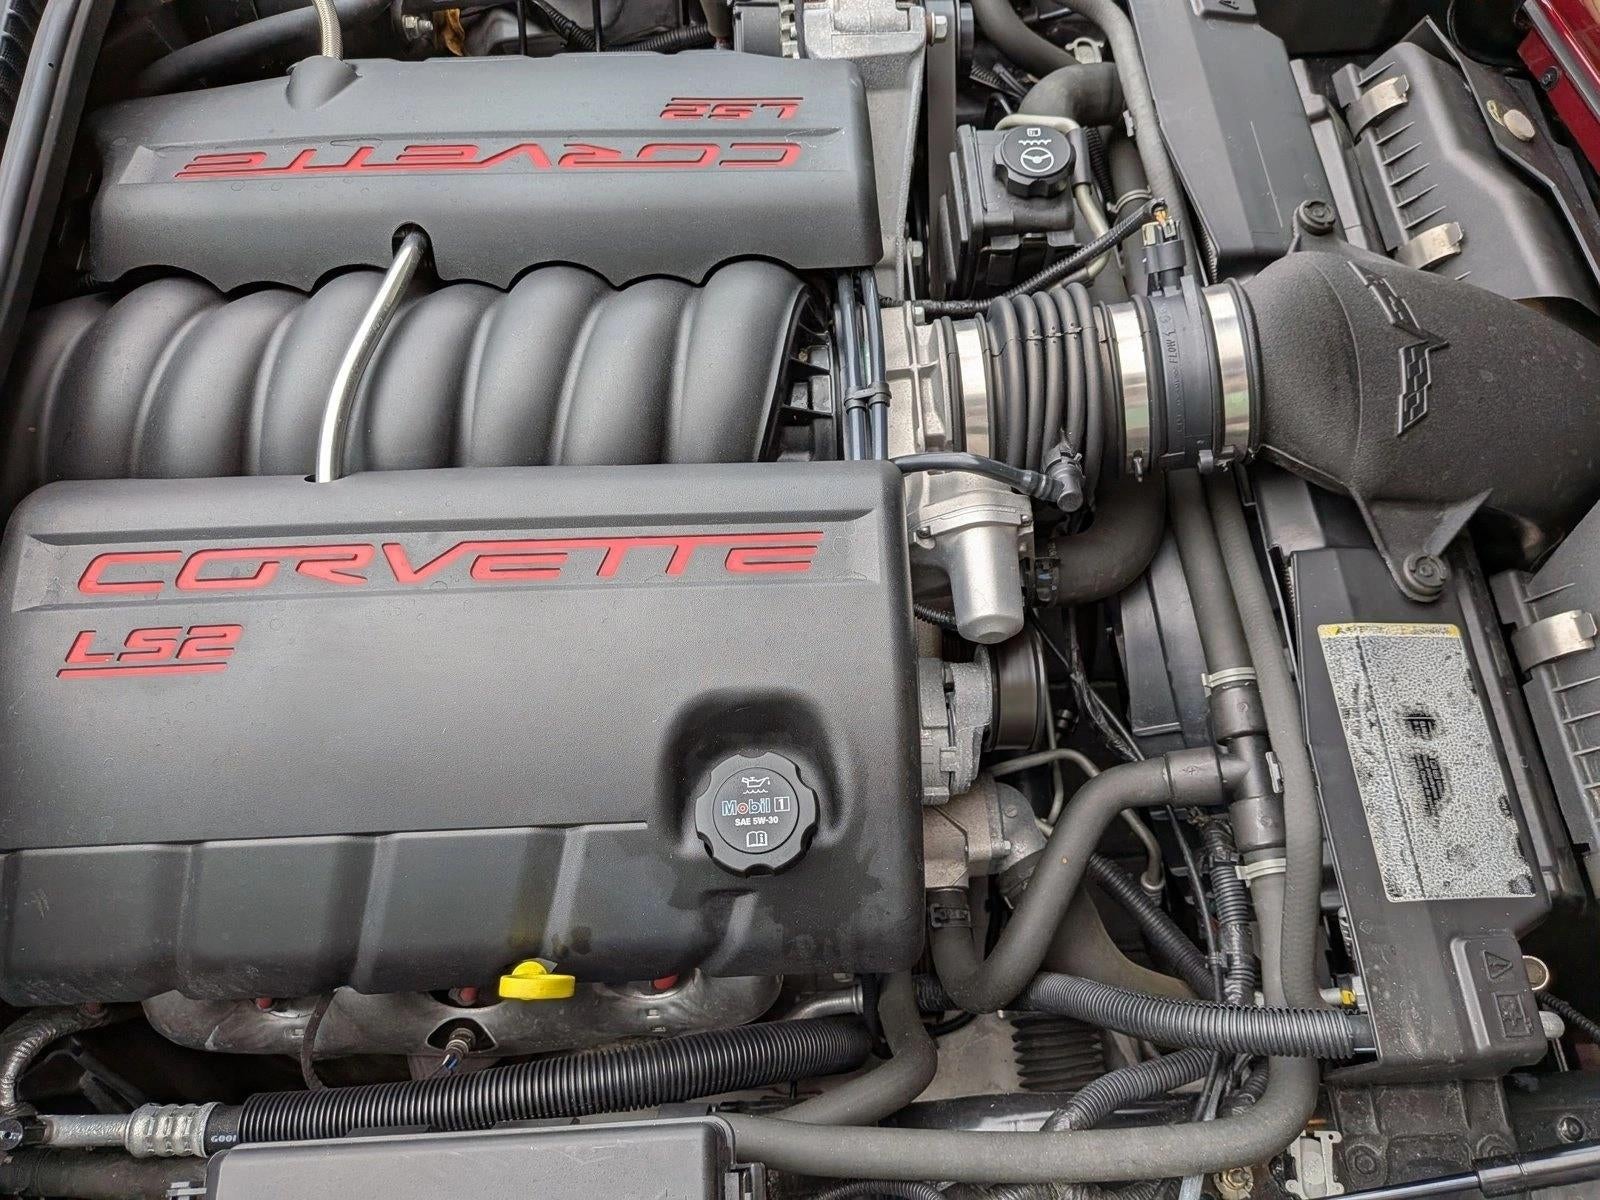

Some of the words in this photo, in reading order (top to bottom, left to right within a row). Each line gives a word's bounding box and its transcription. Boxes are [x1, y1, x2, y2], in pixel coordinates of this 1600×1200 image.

[660, 102, 800, 120] LS2
[175, 142, 802, 180] CORVETTE
[77, 531, 824, 595] CORVETTE
[64, 623, 244, 665] LS2
[721, 798, 771, 816] Mobil
[734, 817, 752, 826] SAE
[752, 816, 779, 825] 5W-30
